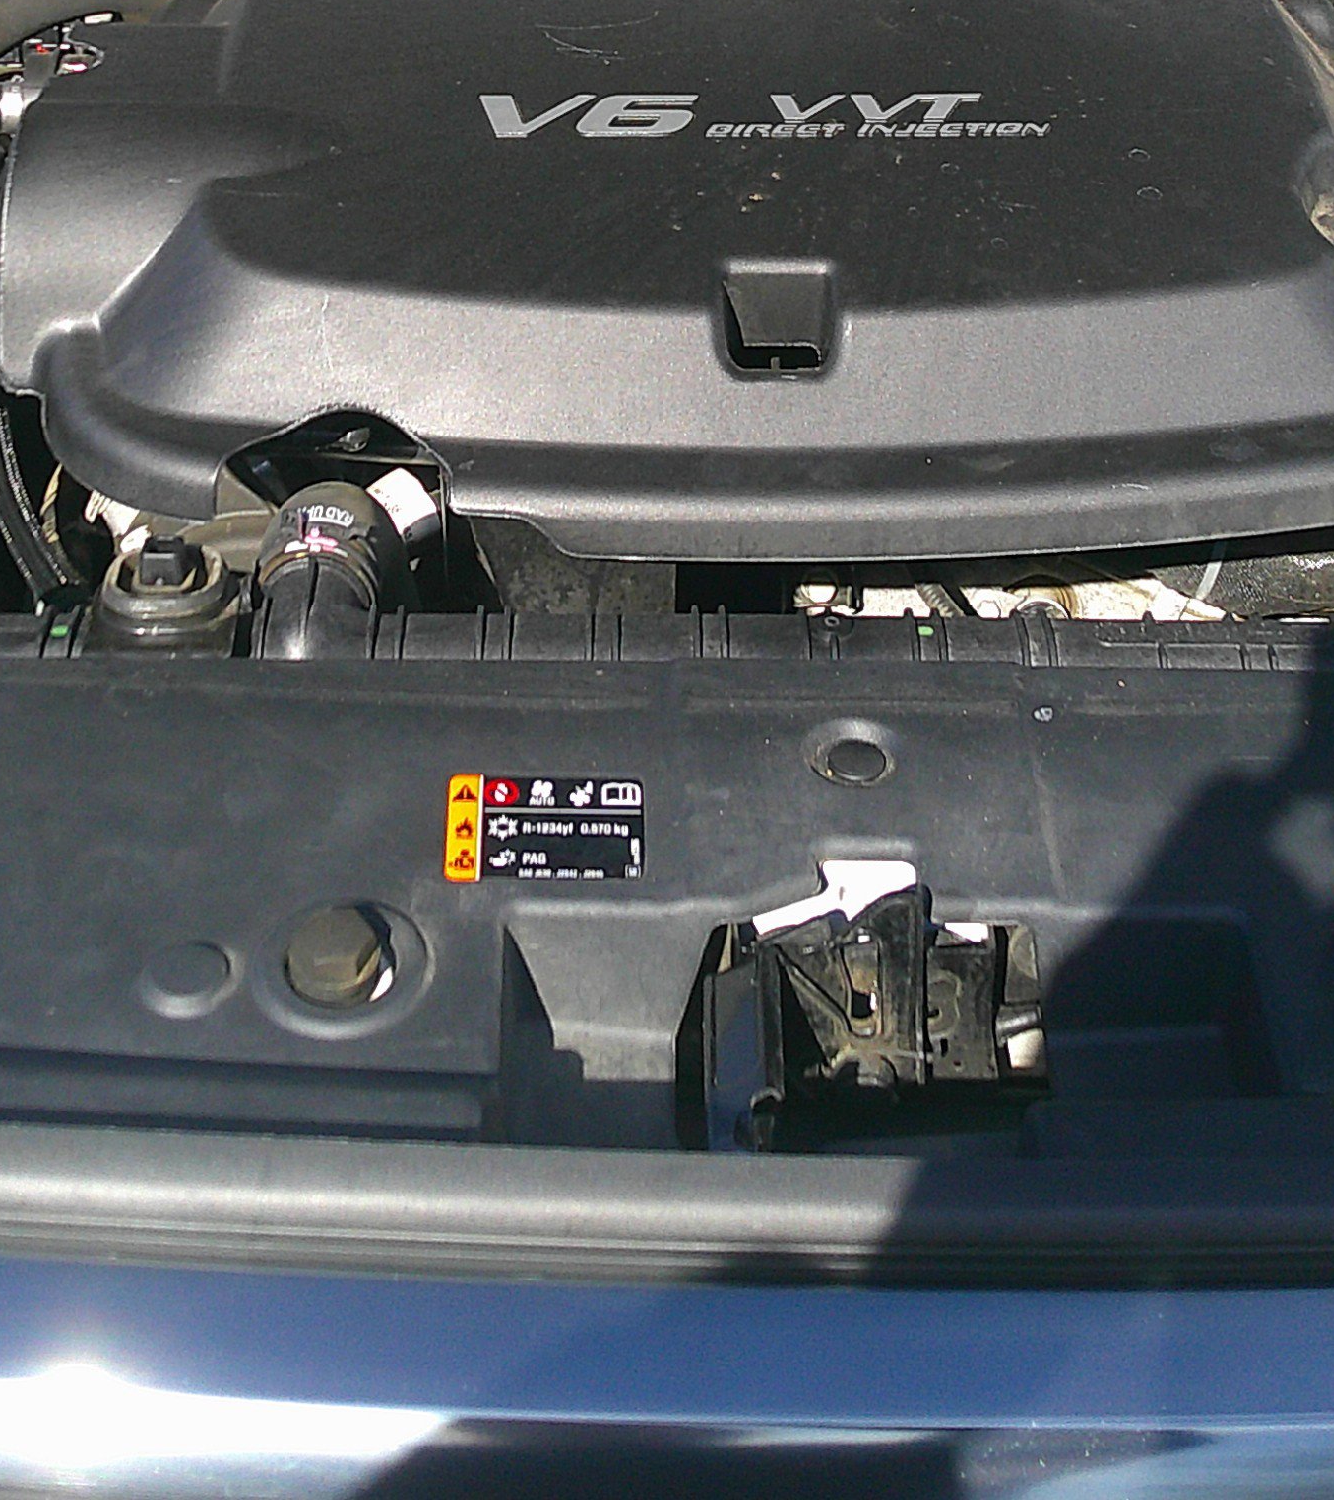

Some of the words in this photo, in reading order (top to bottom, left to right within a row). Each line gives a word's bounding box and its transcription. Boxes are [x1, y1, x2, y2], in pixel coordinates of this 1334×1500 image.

[479, 94, 699, 138] V6
[770, 93, 983, 123] VVT
[705, 123, 845, 137] DIRECT
[856, 122, 1051, 138] INJECTION
[529, 796, 555, 806] AUTO
[522, 852, 547, 865] PAG
